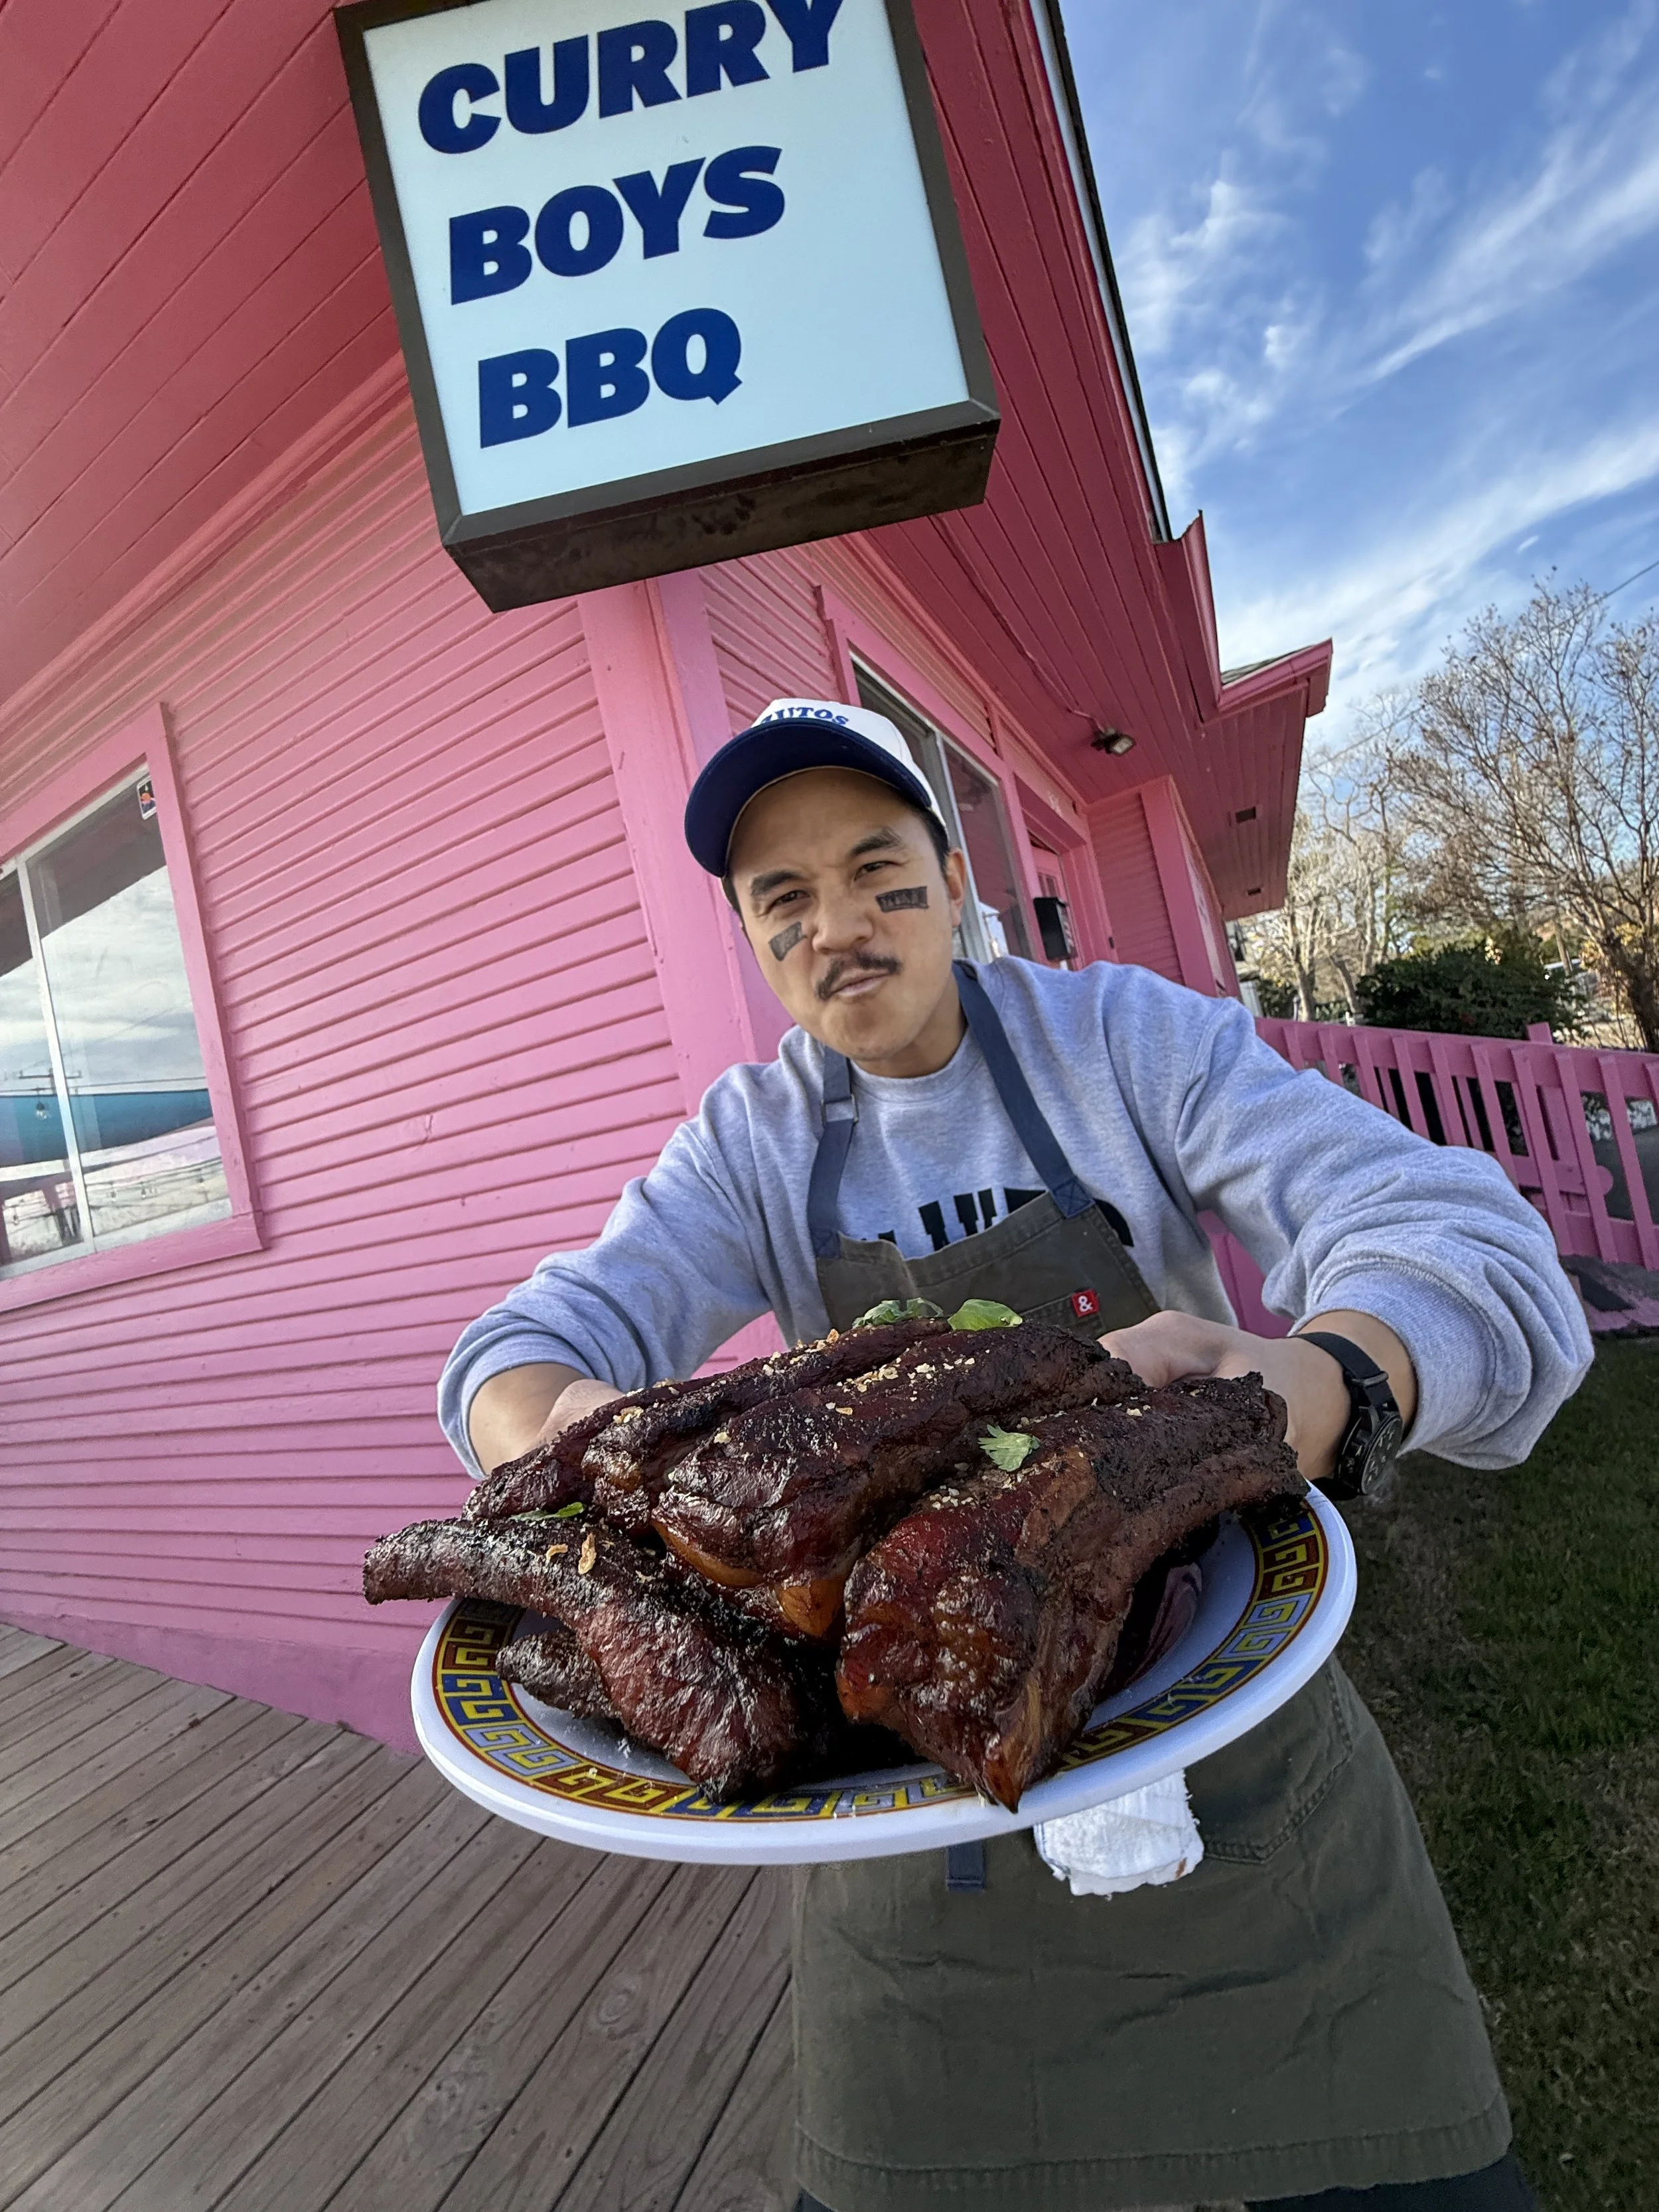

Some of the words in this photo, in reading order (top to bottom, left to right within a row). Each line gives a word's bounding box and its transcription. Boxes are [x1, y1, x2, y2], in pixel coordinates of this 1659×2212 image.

[418, 0, 843, 155] CURRY
[449, 145, 786, 306] BOYS
[478, 307, 743, 449] BBQ
[1078, 1295, 1094, 1312] &
